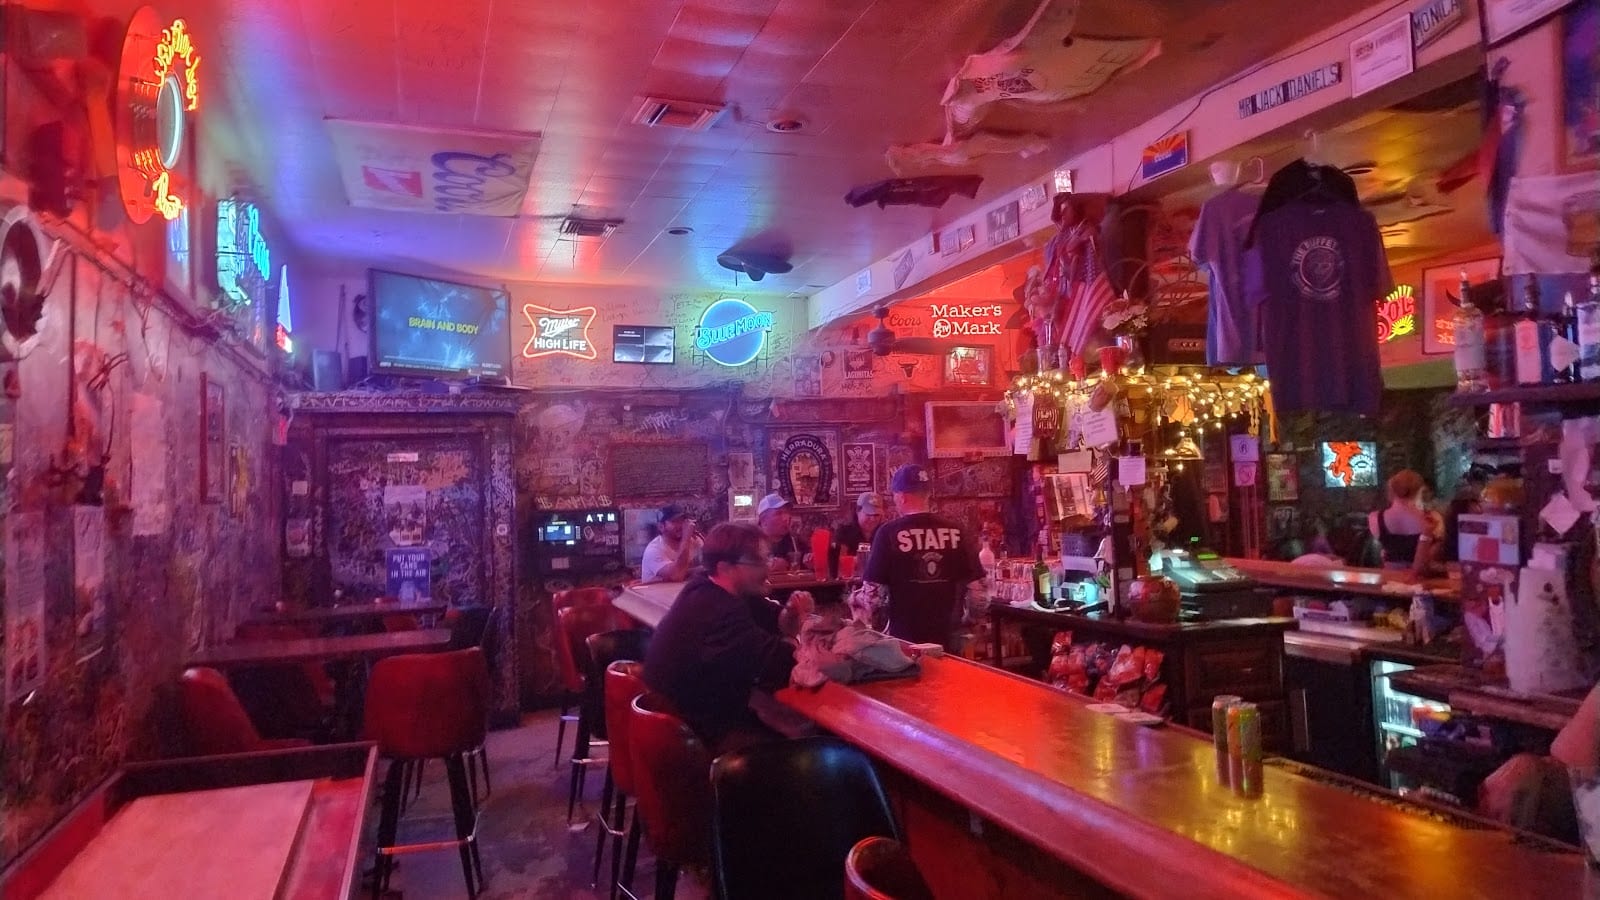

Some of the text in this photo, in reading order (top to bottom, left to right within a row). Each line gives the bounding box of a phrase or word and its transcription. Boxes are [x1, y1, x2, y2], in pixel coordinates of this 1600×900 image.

[1255, 85, 1284, 110] JACK
[889, 313, 921, 327] Coors
[930, 304, 1002, 318] Maker's
[408, 316, 479, 335] BRAIN AND BODY
[538, 317, 581, 338] Miller
[696, 312, 773, 350] BLUE MOON
[952, 321, 1002, 335] Mark
[534, 337, 587, 351] HIGH LIFE
[782, 440, 827, 460] HERRADURA
[586, 513, 615, 523] ATM
[896, 528, 960, 552] STAFF
